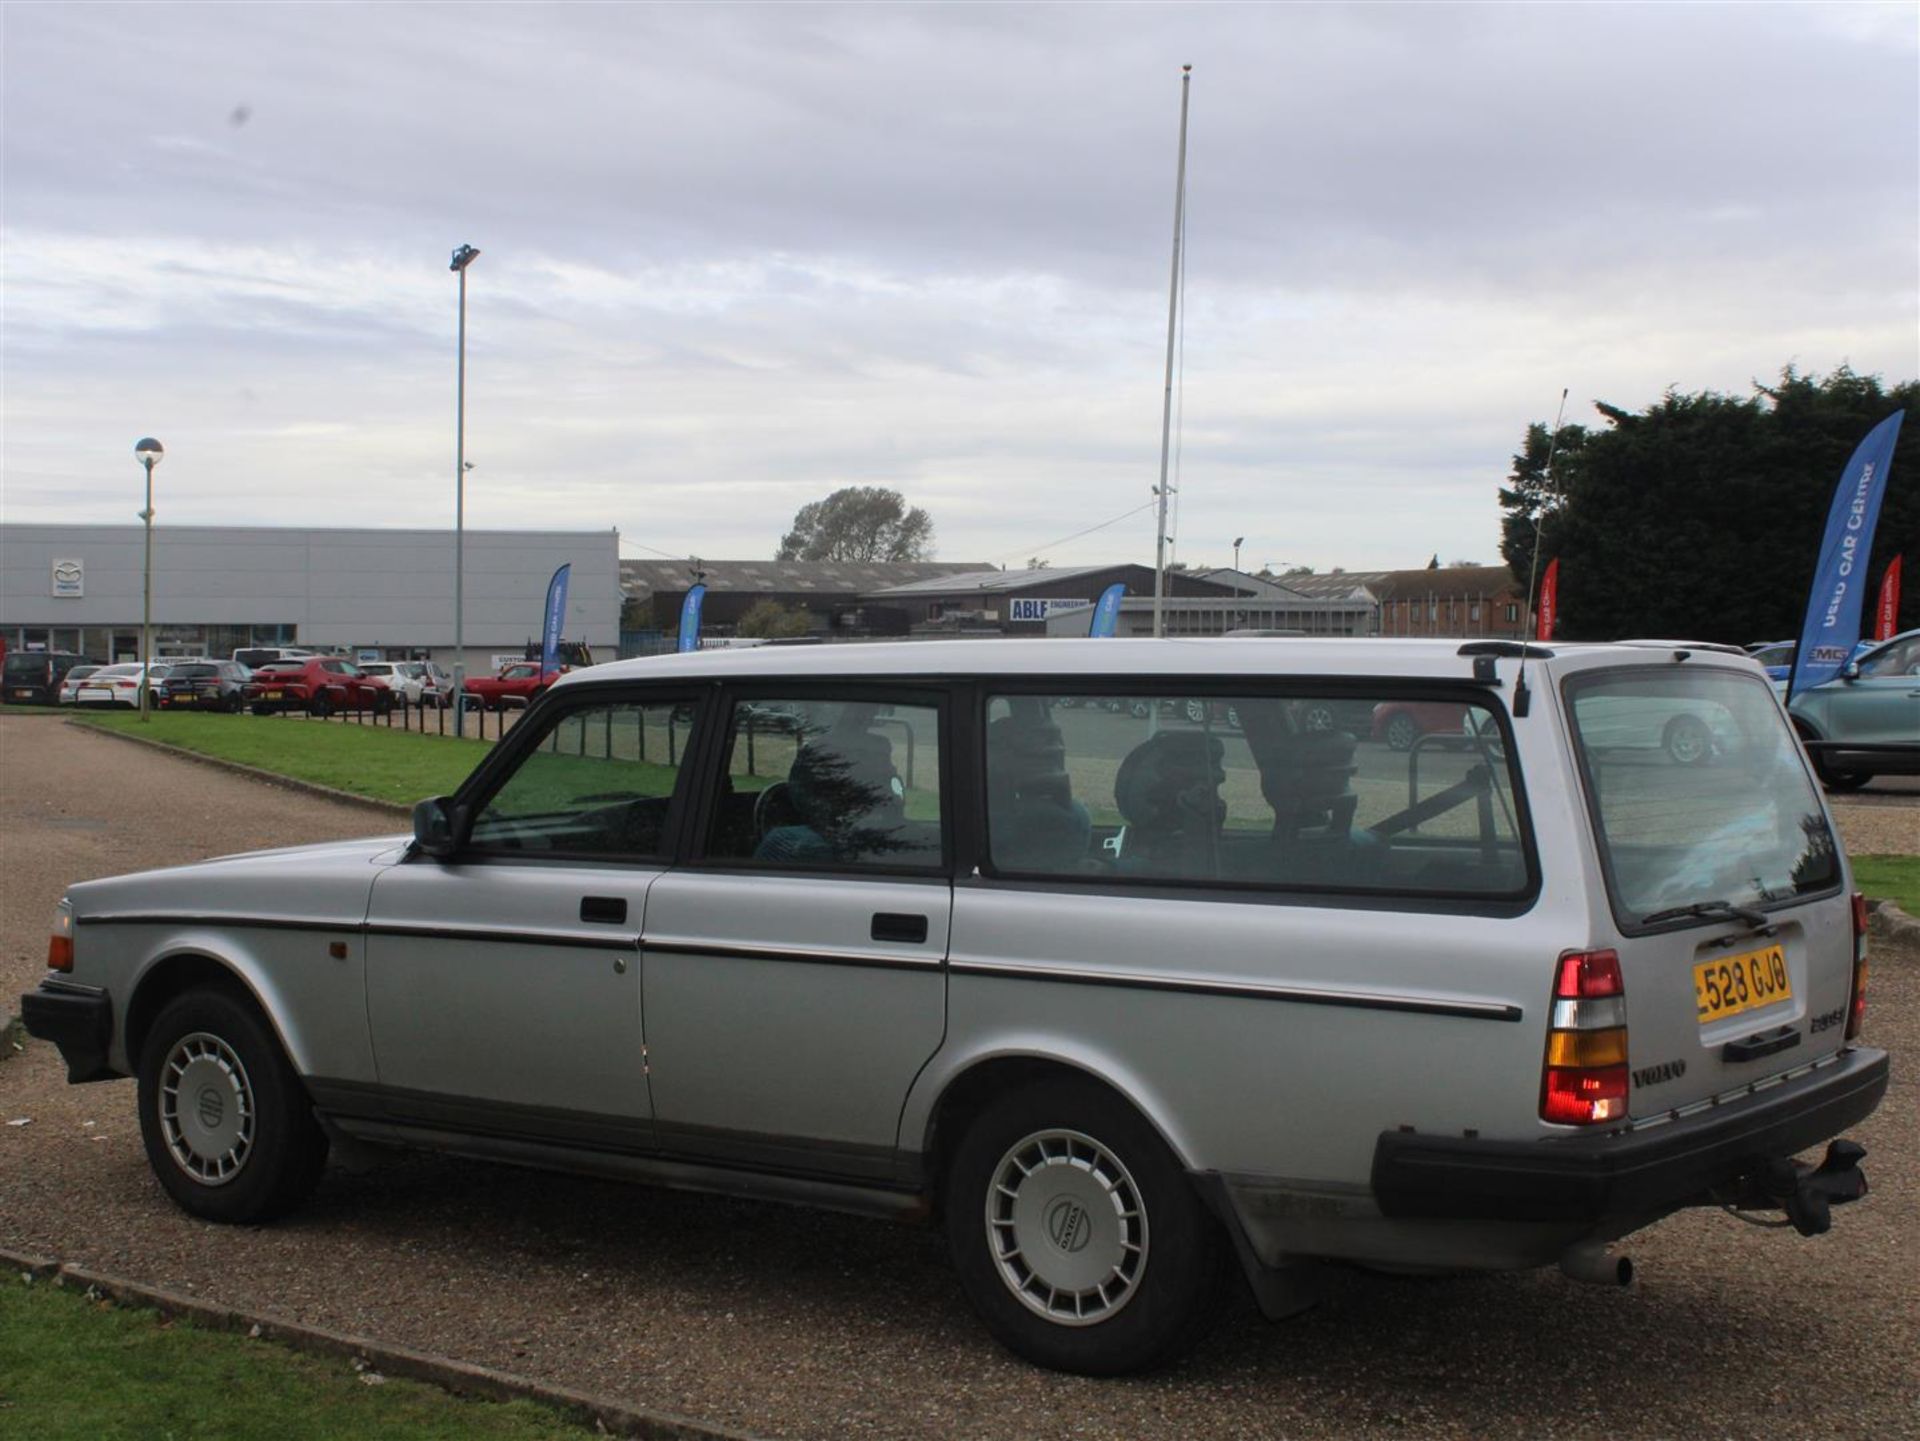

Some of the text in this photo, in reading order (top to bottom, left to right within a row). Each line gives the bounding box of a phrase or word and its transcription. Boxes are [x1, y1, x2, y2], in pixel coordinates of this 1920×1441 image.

[1823, 582, 1847, 628] USED
[1839, 535, 1858, 577] CAR
[1632, 1058, 1687, 1089] VOLVO
